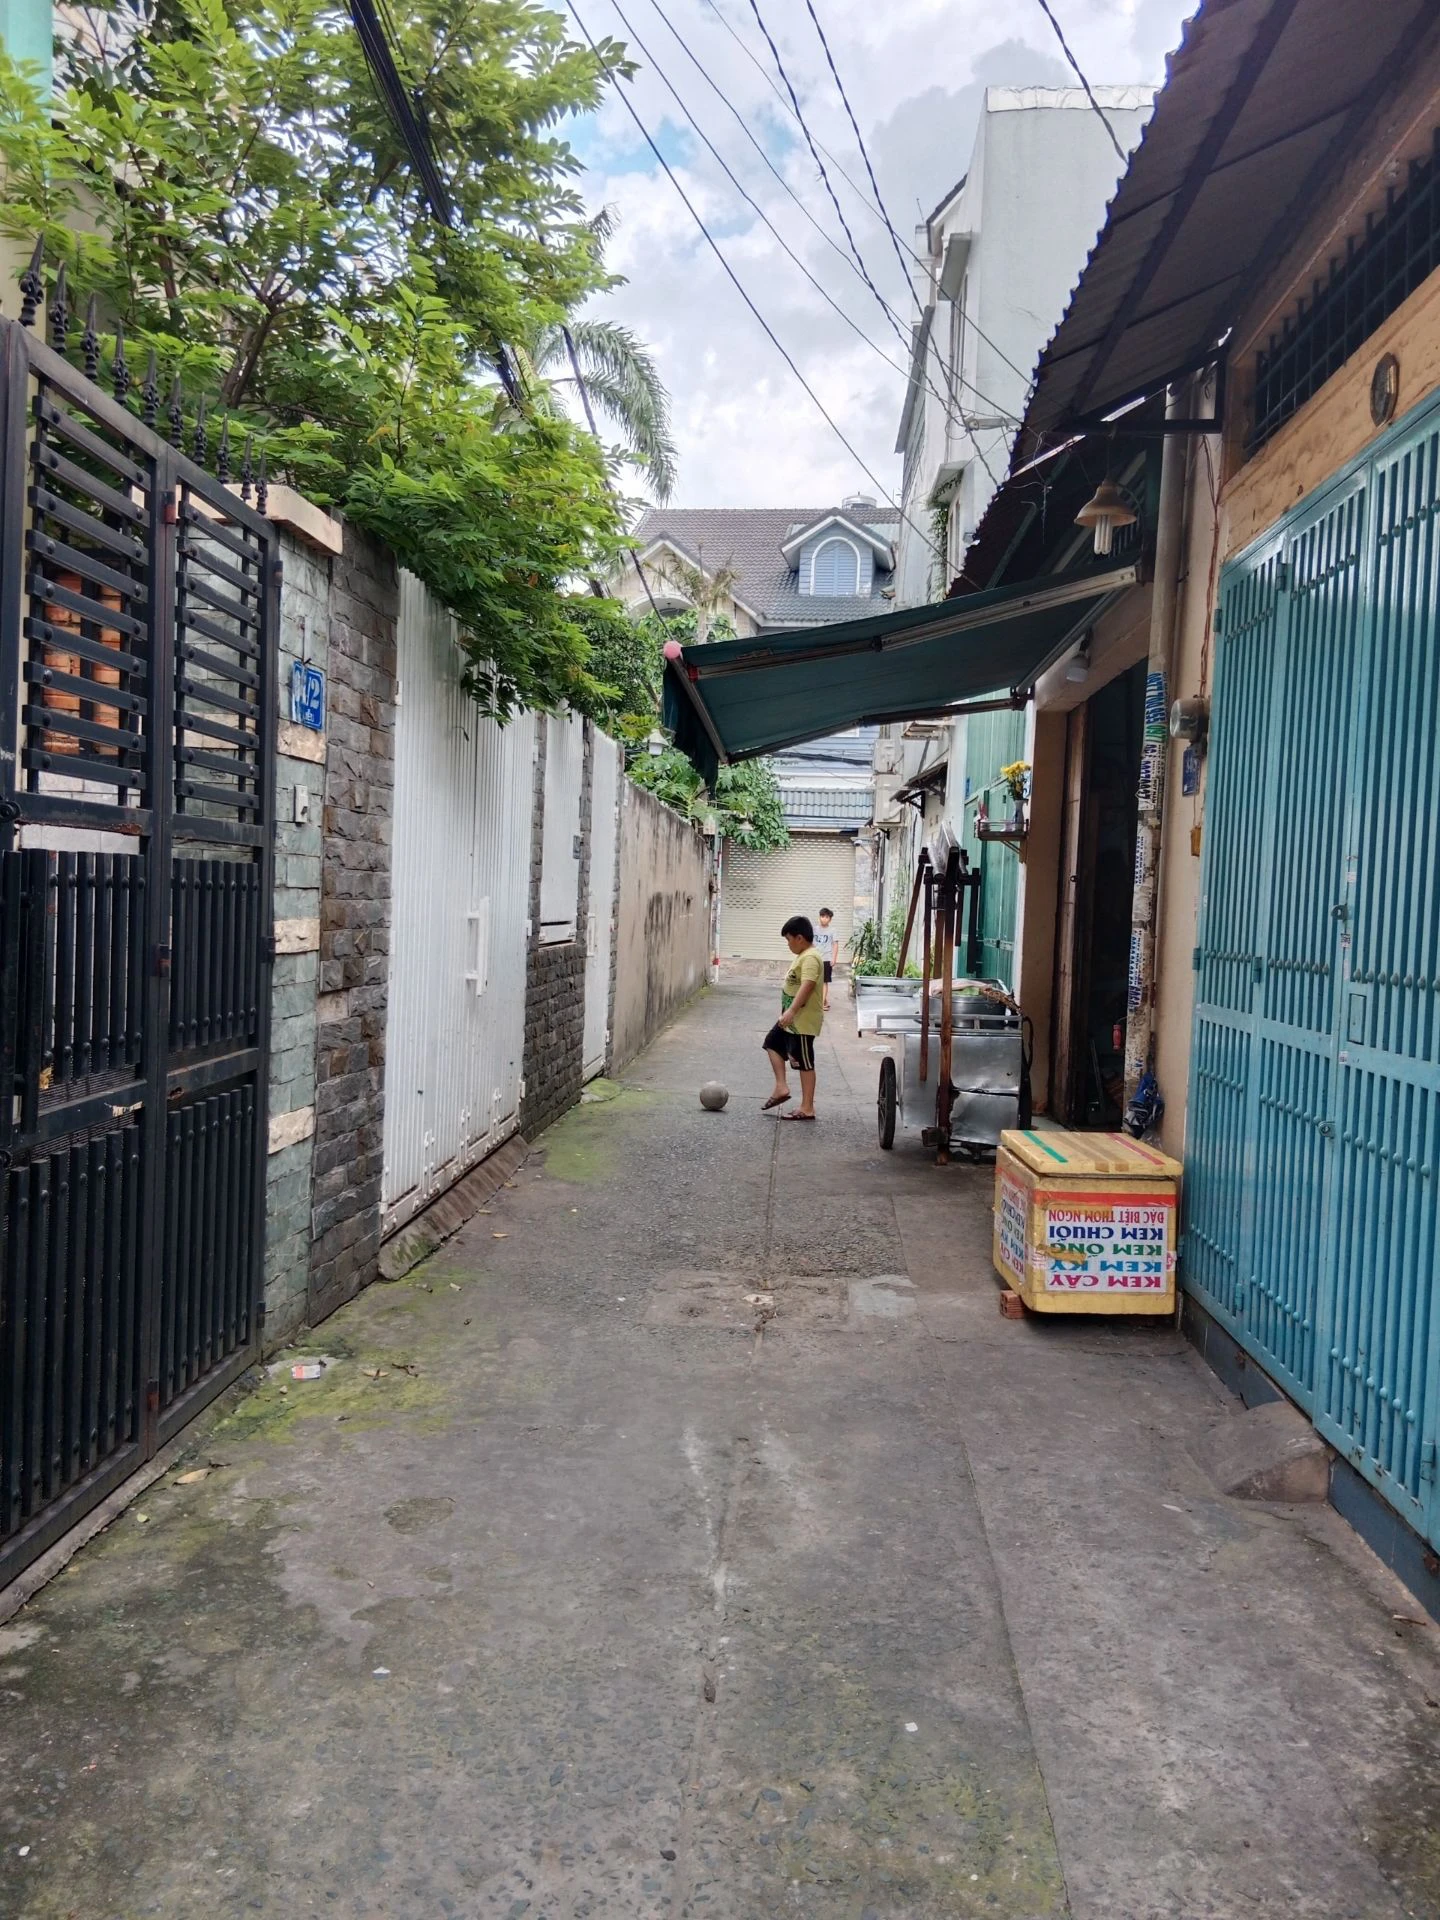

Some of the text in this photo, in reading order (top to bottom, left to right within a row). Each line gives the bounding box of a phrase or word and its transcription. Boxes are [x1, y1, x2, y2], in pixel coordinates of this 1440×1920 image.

[1049, 1208, 1164, 1225] ĐẶC BIỆT THƠM NGON
[1049, 1225, 1163, 1242] KEM CHUỐI
[1050, 1243, 1162, 1258] KEM ỐNG
[1100, 1260, 1162, 1273] KEM
[1050, 1274, 1160, 1289] KEM CÂY
